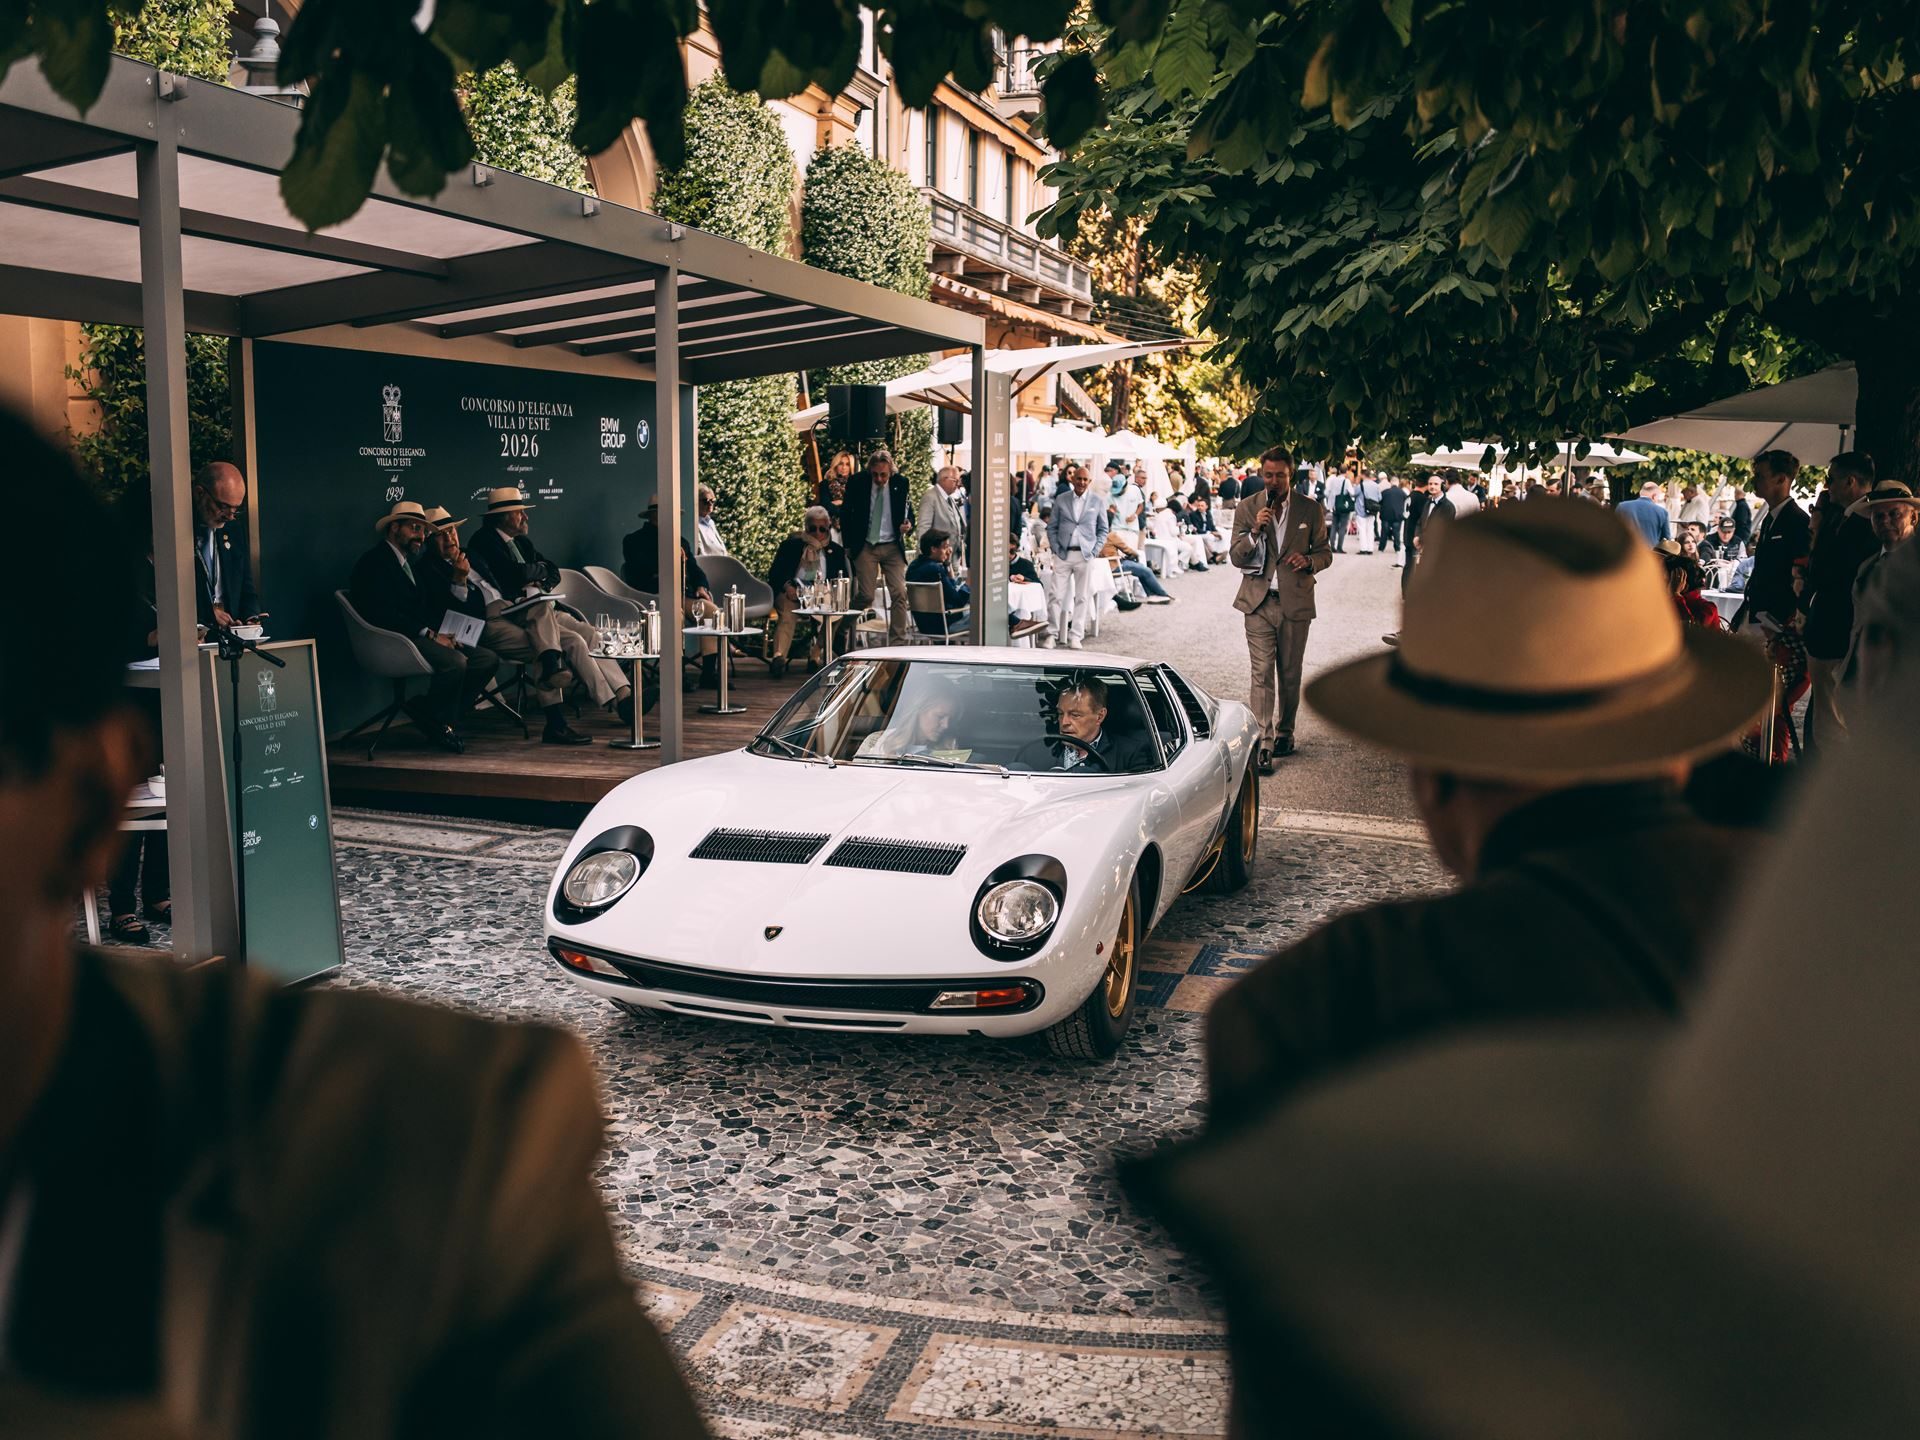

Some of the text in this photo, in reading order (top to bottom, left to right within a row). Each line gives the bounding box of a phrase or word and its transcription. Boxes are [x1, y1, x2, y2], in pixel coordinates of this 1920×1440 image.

[461, 396, 573, 417] CONCORSO D'ELEGANZA
[487, 415, 551, 431] VILLA D'ESTE
[600, 417, 620, 432] BMW
[500, 433, 539, 457] 2026
[600, 433, 626, 448] GROUP
[359, 447, 426, 457] CONCORSO D'ELEGANZA
[376, 458, 412, 467] VILLA D'ESTE
[385, 486, 405, 502] 1929
[239, 716, 269, 727] CONCORSO
[254, 723, 269, 731] VILLA
[264, 742, 281, 756] 1929
